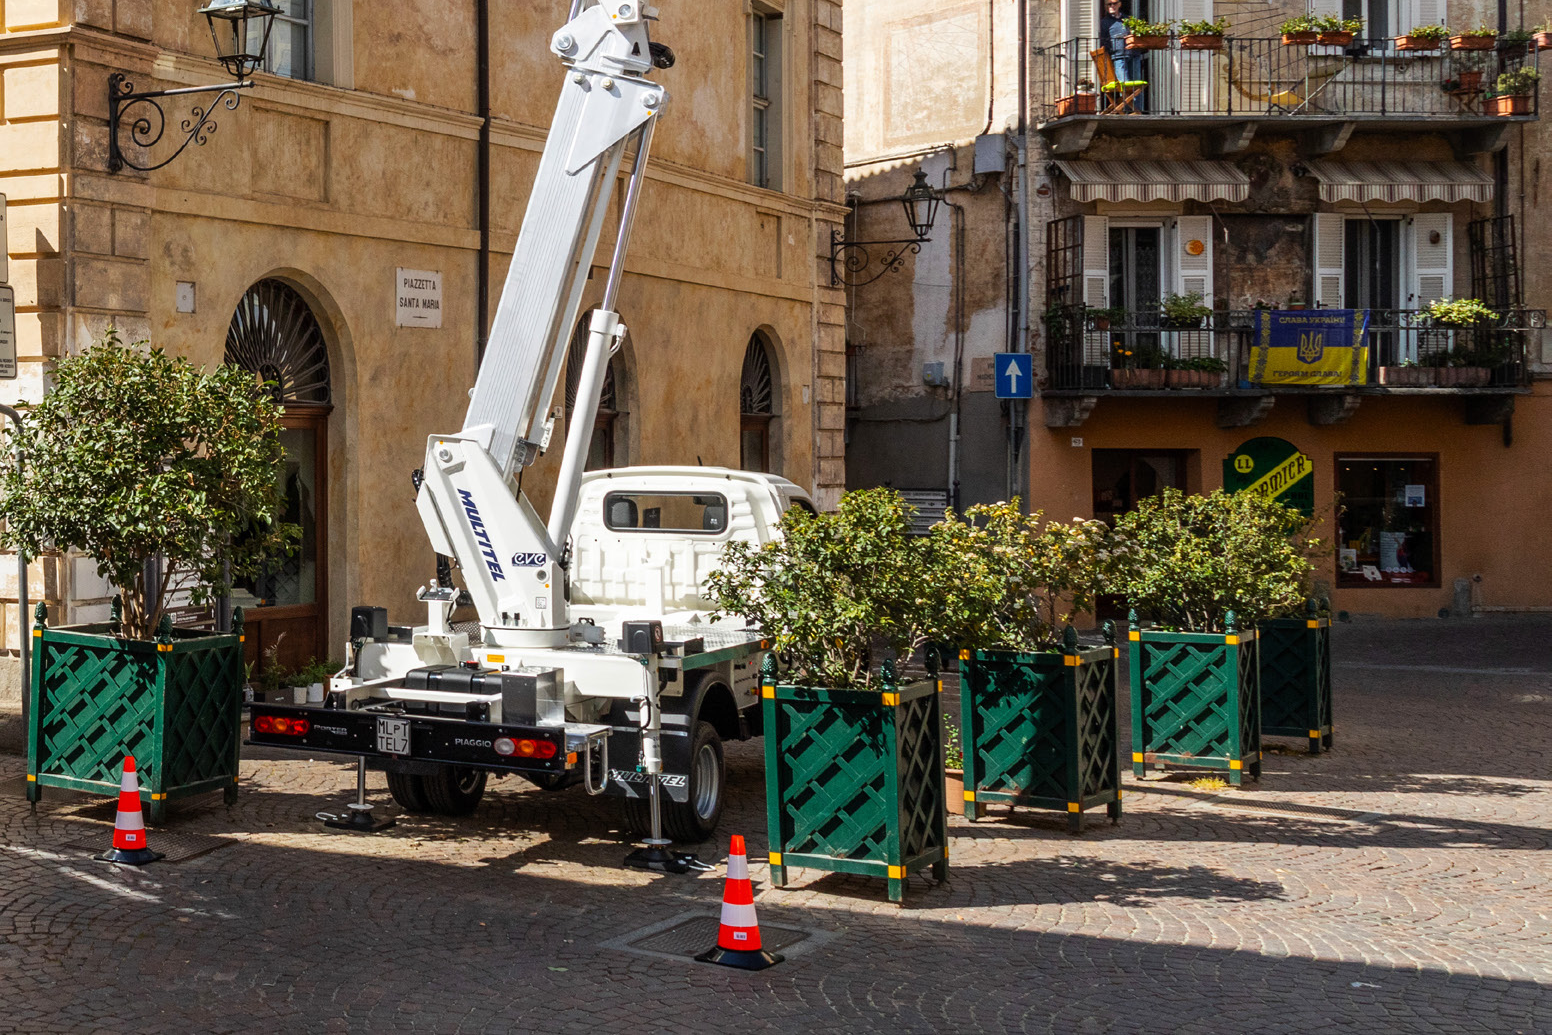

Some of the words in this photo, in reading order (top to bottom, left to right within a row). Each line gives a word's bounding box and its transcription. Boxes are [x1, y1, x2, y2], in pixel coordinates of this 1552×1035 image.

[403, 278, 436, 291] PIAZZETTA
[399, 297, 420, 309] SANTA
[422, 298, 440, 310] MARIA
[1278, 316, 1308, 324] СЛАВА
[457, 488, 505, 582] MULTITEL
[514, 553, 545, 565] eve
[314, 724, 347, 733] PORTER
[378, 735, 408, 752] TEL7
[454, 738, 491, 748] PIAGGIO
[608, 769, 687, 787] MULTTEL
